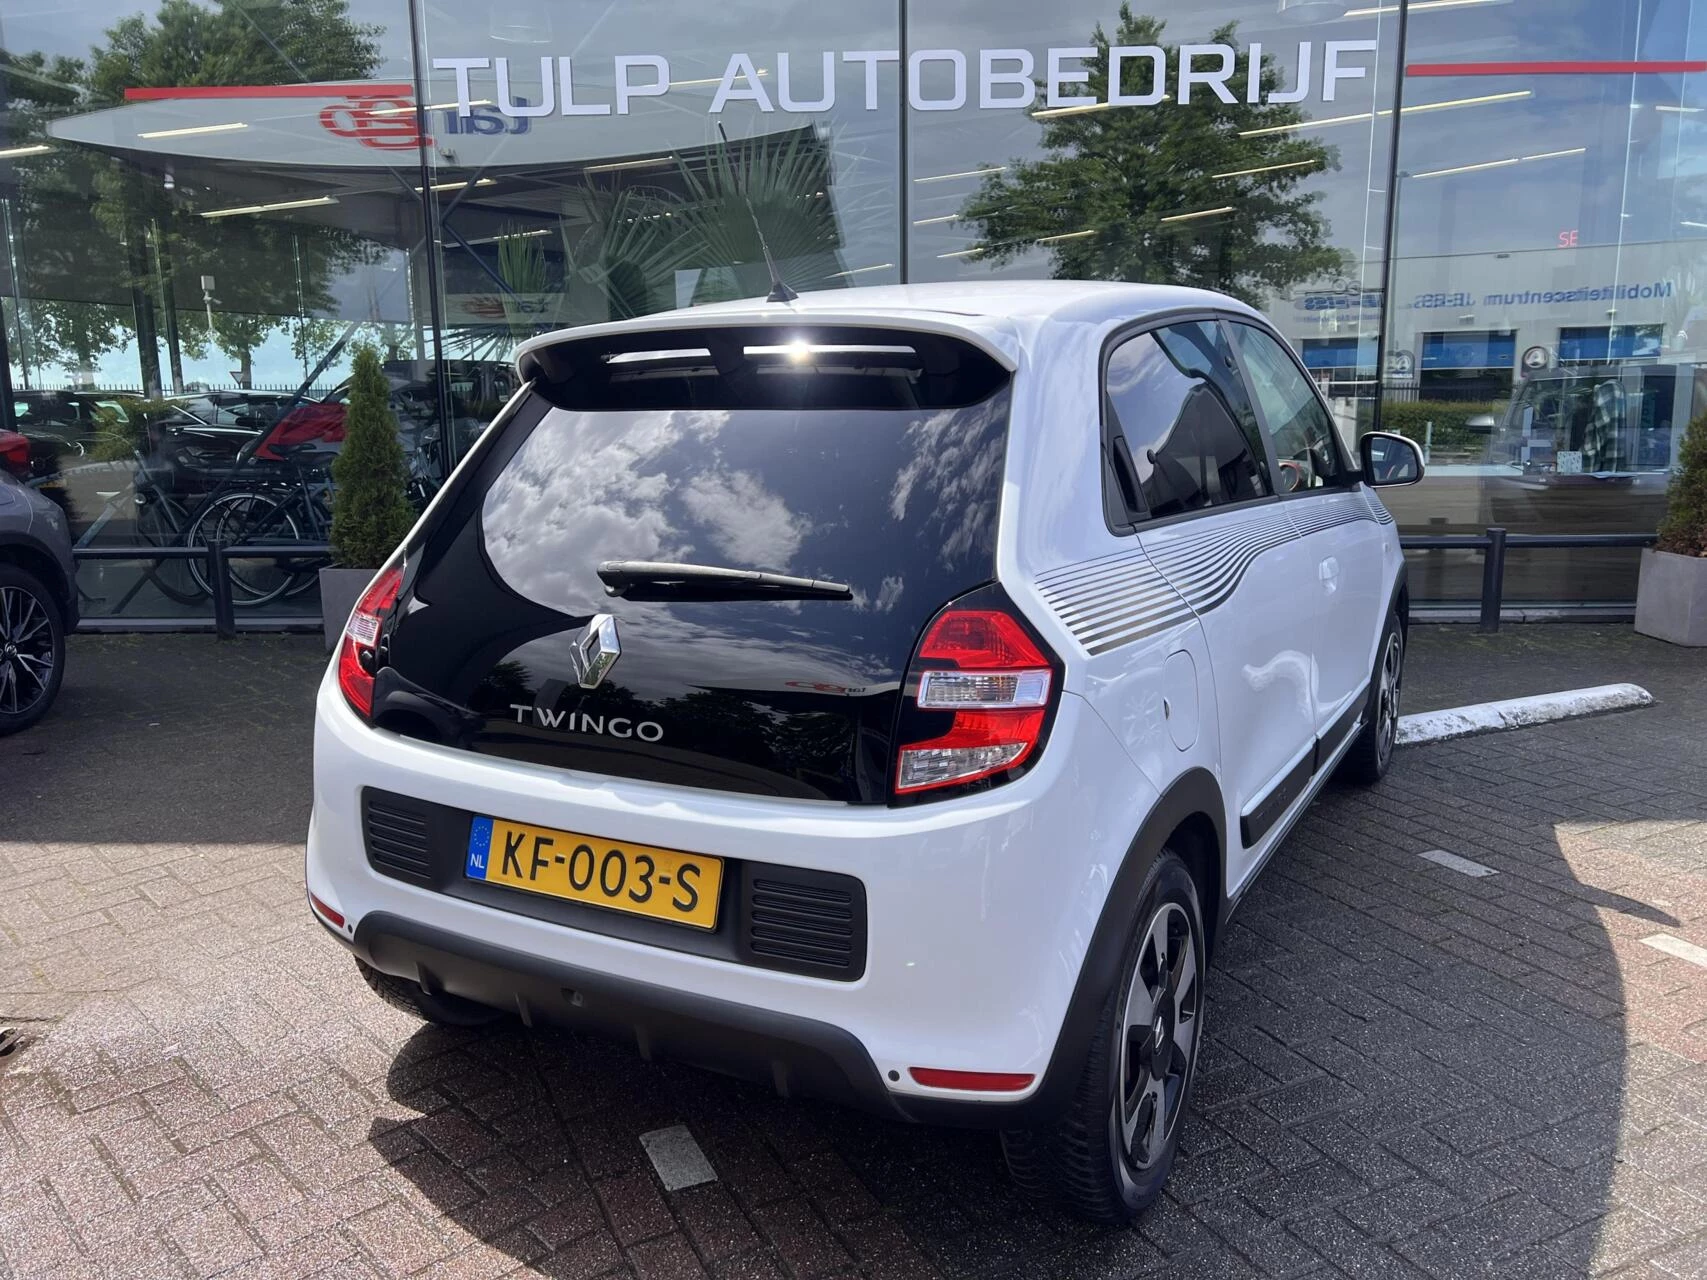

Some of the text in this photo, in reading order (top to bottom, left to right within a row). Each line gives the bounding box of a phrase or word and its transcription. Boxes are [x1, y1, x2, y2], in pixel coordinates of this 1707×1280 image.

[432, 39, 1377, 118] TULP AUTOBEDRIJF
[510, 703, 664, 743] TWINGO
[469, 852, 485, 870] NL
[501, 829, 702, 912] KF-003-S
